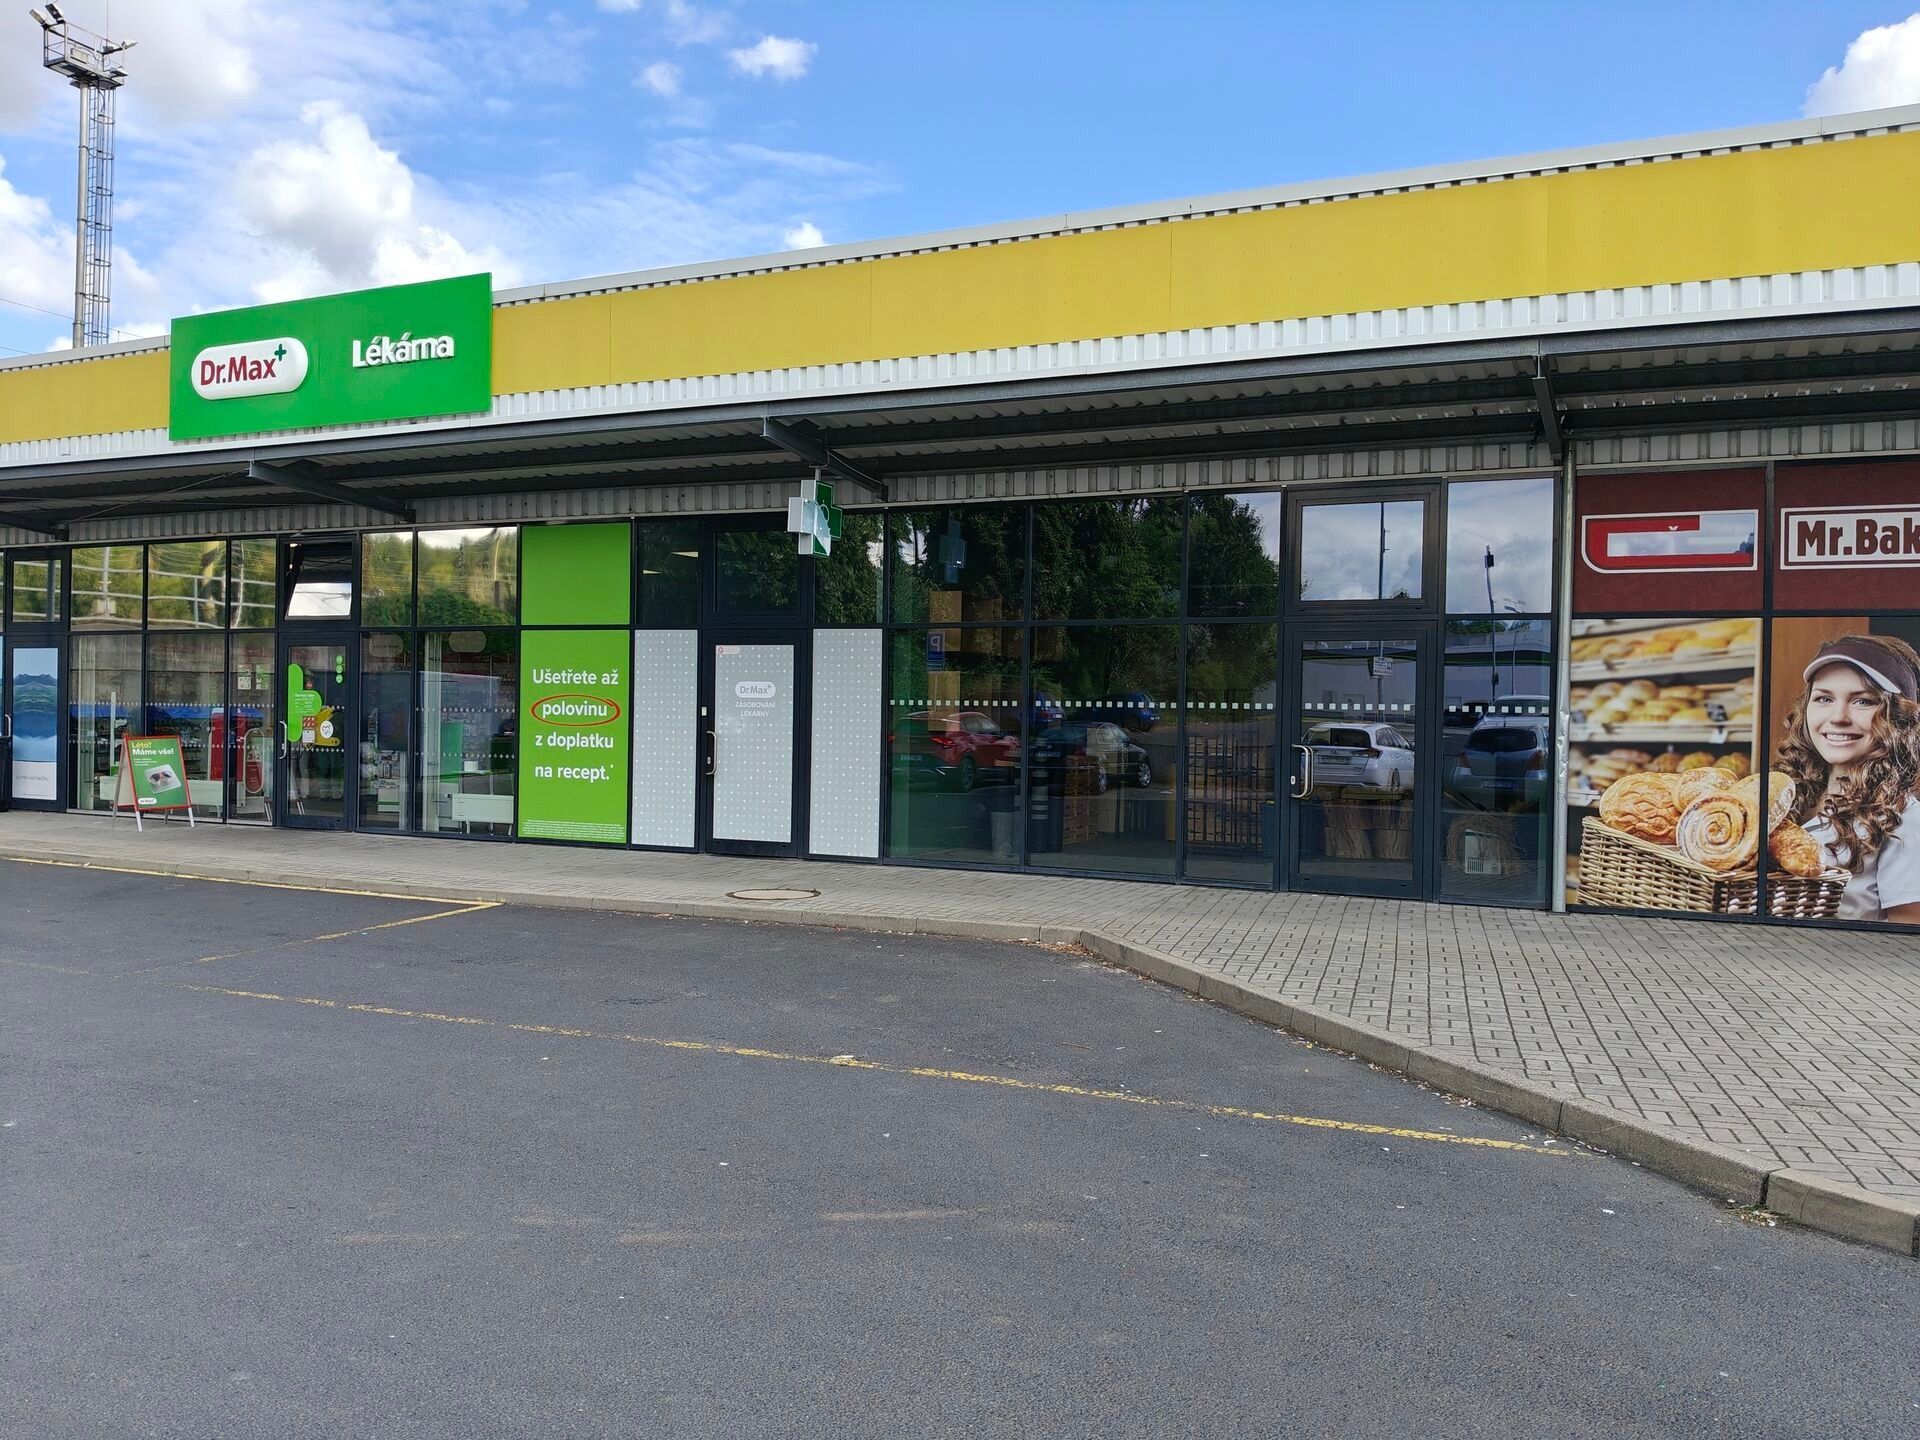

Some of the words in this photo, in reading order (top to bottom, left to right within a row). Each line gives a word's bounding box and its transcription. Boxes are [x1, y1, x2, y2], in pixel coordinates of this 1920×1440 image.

[352, 332, 455, 368] Lékárna
[1797, 517, 1920, 556] Mr.Bak
[532, 668, 597, 685] Ušetřete
[601, 668, 619, 685] až
[542, 700, 608, 719] polovinu
[535, 734, 544, 746] z
[547, 731, 614, 751] doplatku
[132, 748, 157, 756] Máme
[158, 747, 174, 755] vše!
[534, 765, 553, 778] na
